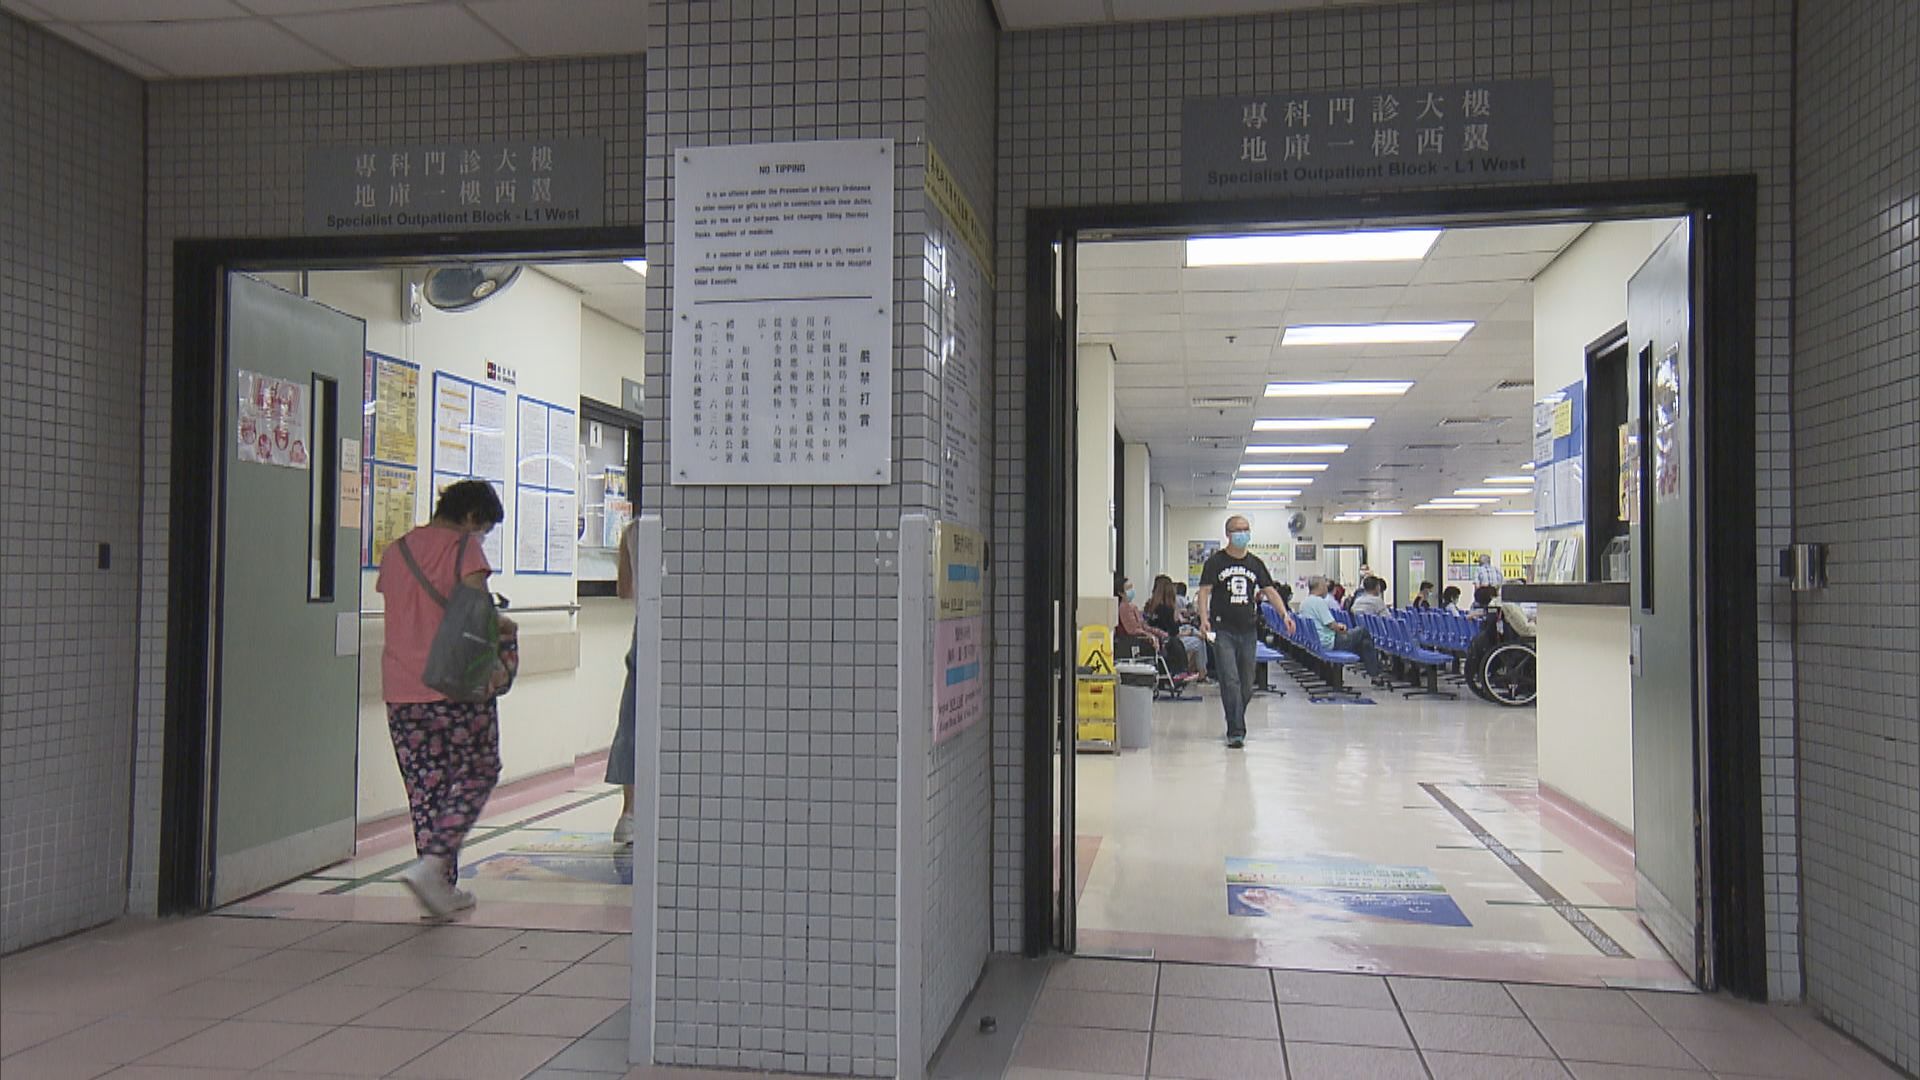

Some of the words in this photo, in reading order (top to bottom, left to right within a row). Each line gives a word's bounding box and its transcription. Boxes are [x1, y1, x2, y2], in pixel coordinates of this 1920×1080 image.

[1242, 88, 1490, 130] 專科門診大樓
[1240, 124, 1490, 163] 地庫一樓西翼
[355, 146, 552, 178] 專科門診大樓
[759, 165, 770, 175] NO
[775, 163, 805, 174] TIPPING
[1207, 168, 1289, 187] Specialist
[1294, 163, 1383, 182] Outpatient
[1388, 160, 1437, 176] Block
[1455, 159, 1473, 173] L1
[1482, 157, 1526, 172] West
[354, 178, 551, 208] 地庫一樓西翼
[327, 212, 392, 230] Specialist
[397, 210, 468, 227] Outpatient
[472, 208, 511, 224] Block
[525, 208, 540, 222] L1
[544, 207, 580, 221] West
[858, 349, 871, 428] 嚴禁打賞
